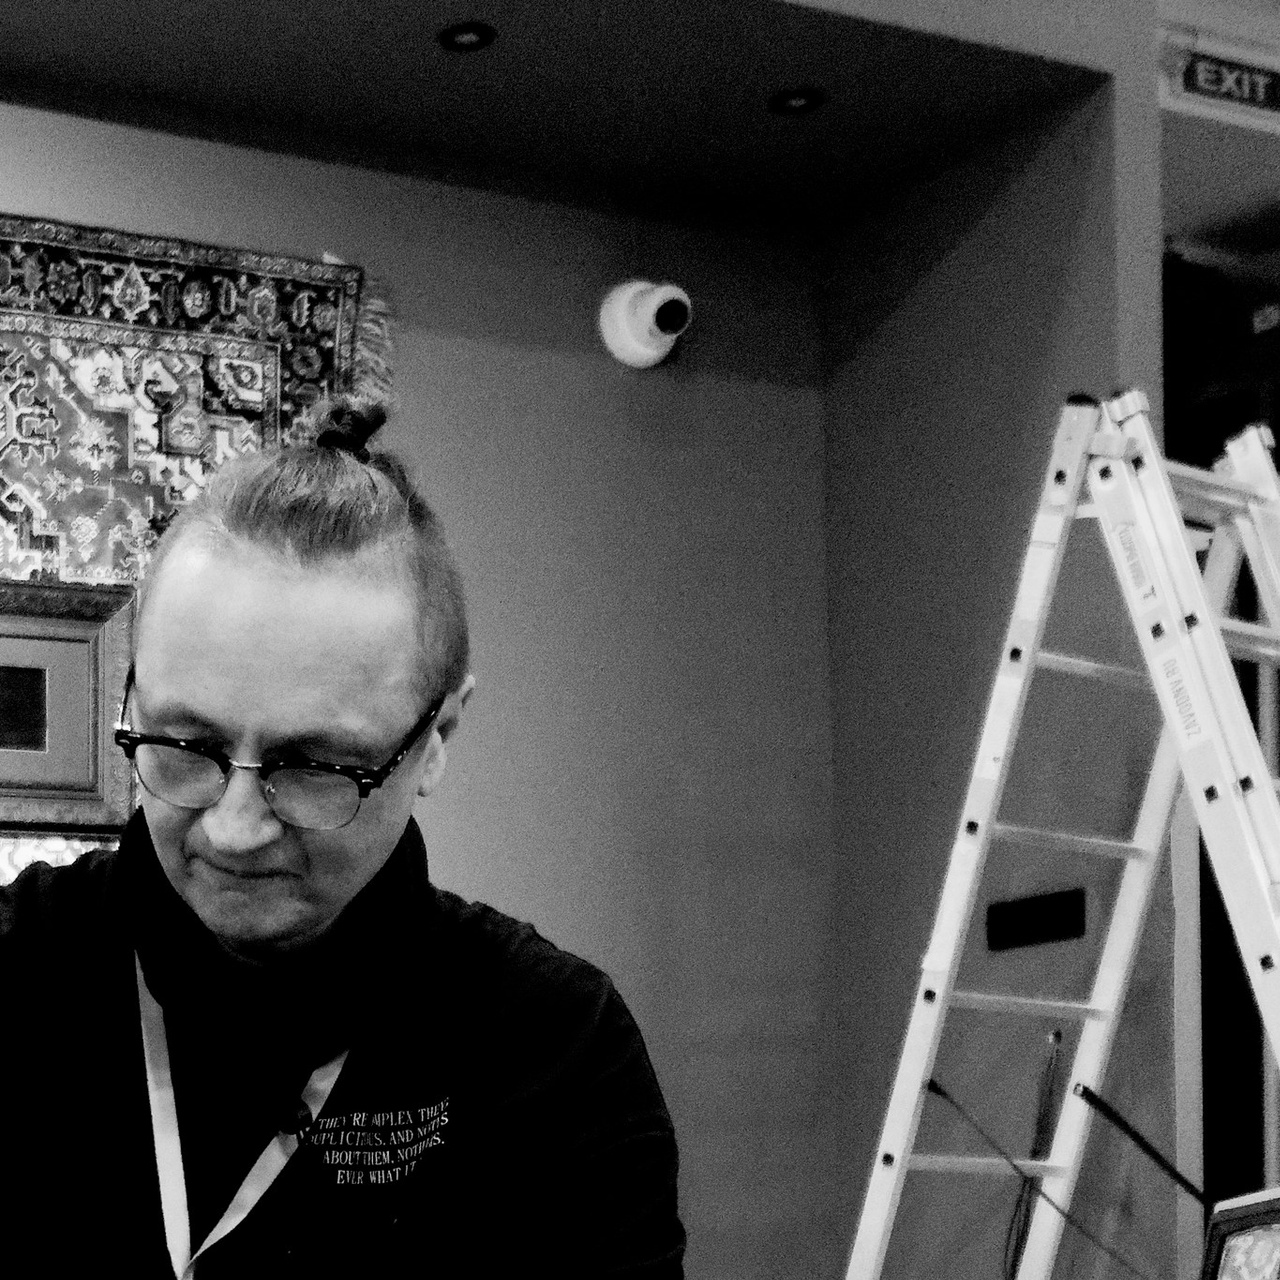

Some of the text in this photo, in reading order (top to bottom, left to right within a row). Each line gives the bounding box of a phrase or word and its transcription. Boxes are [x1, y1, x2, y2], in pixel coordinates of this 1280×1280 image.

[1197, 61, 1271, 101] EXIT
[389, 1129, 414, 1146] AND
[323, 1150, 361, 1166] ABOUT
[336, 1169, 364, 1185] EVER
[369, 1167, 402, 1184] WHAT
